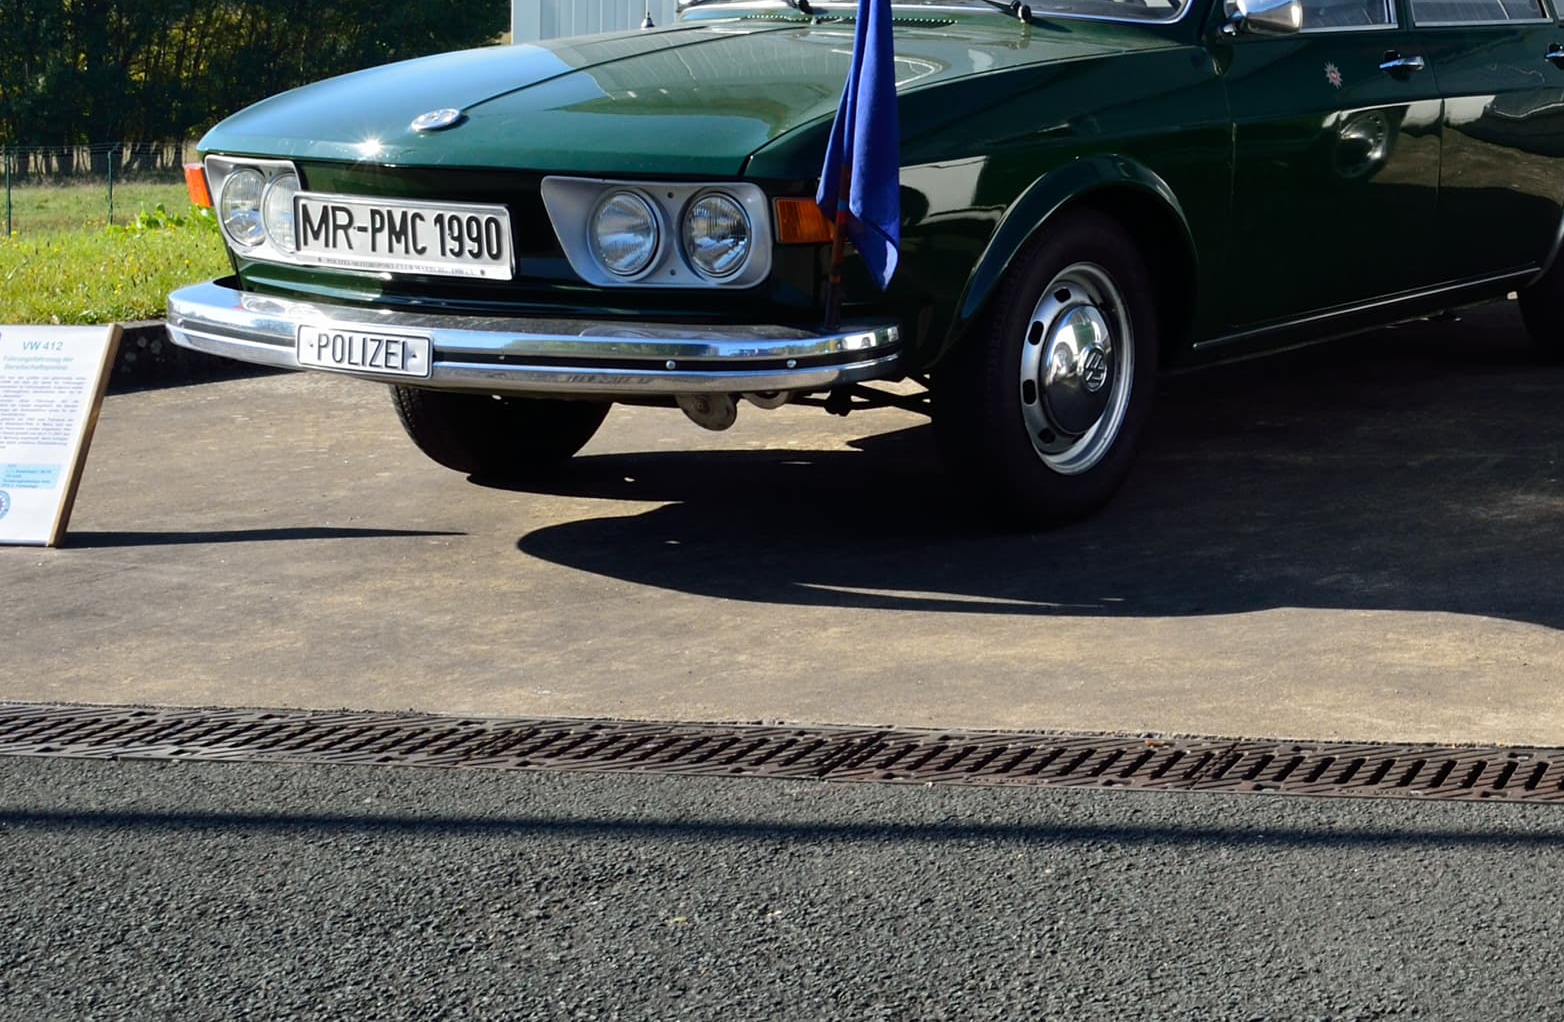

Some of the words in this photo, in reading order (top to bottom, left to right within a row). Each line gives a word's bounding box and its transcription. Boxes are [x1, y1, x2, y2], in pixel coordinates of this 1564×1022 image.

[433, 212, 503, 261] 1990
[22, 341, 41, 351] VW
[43, 341, 64, 351] 412
[316, 332, 408, 371] POLIZEI
